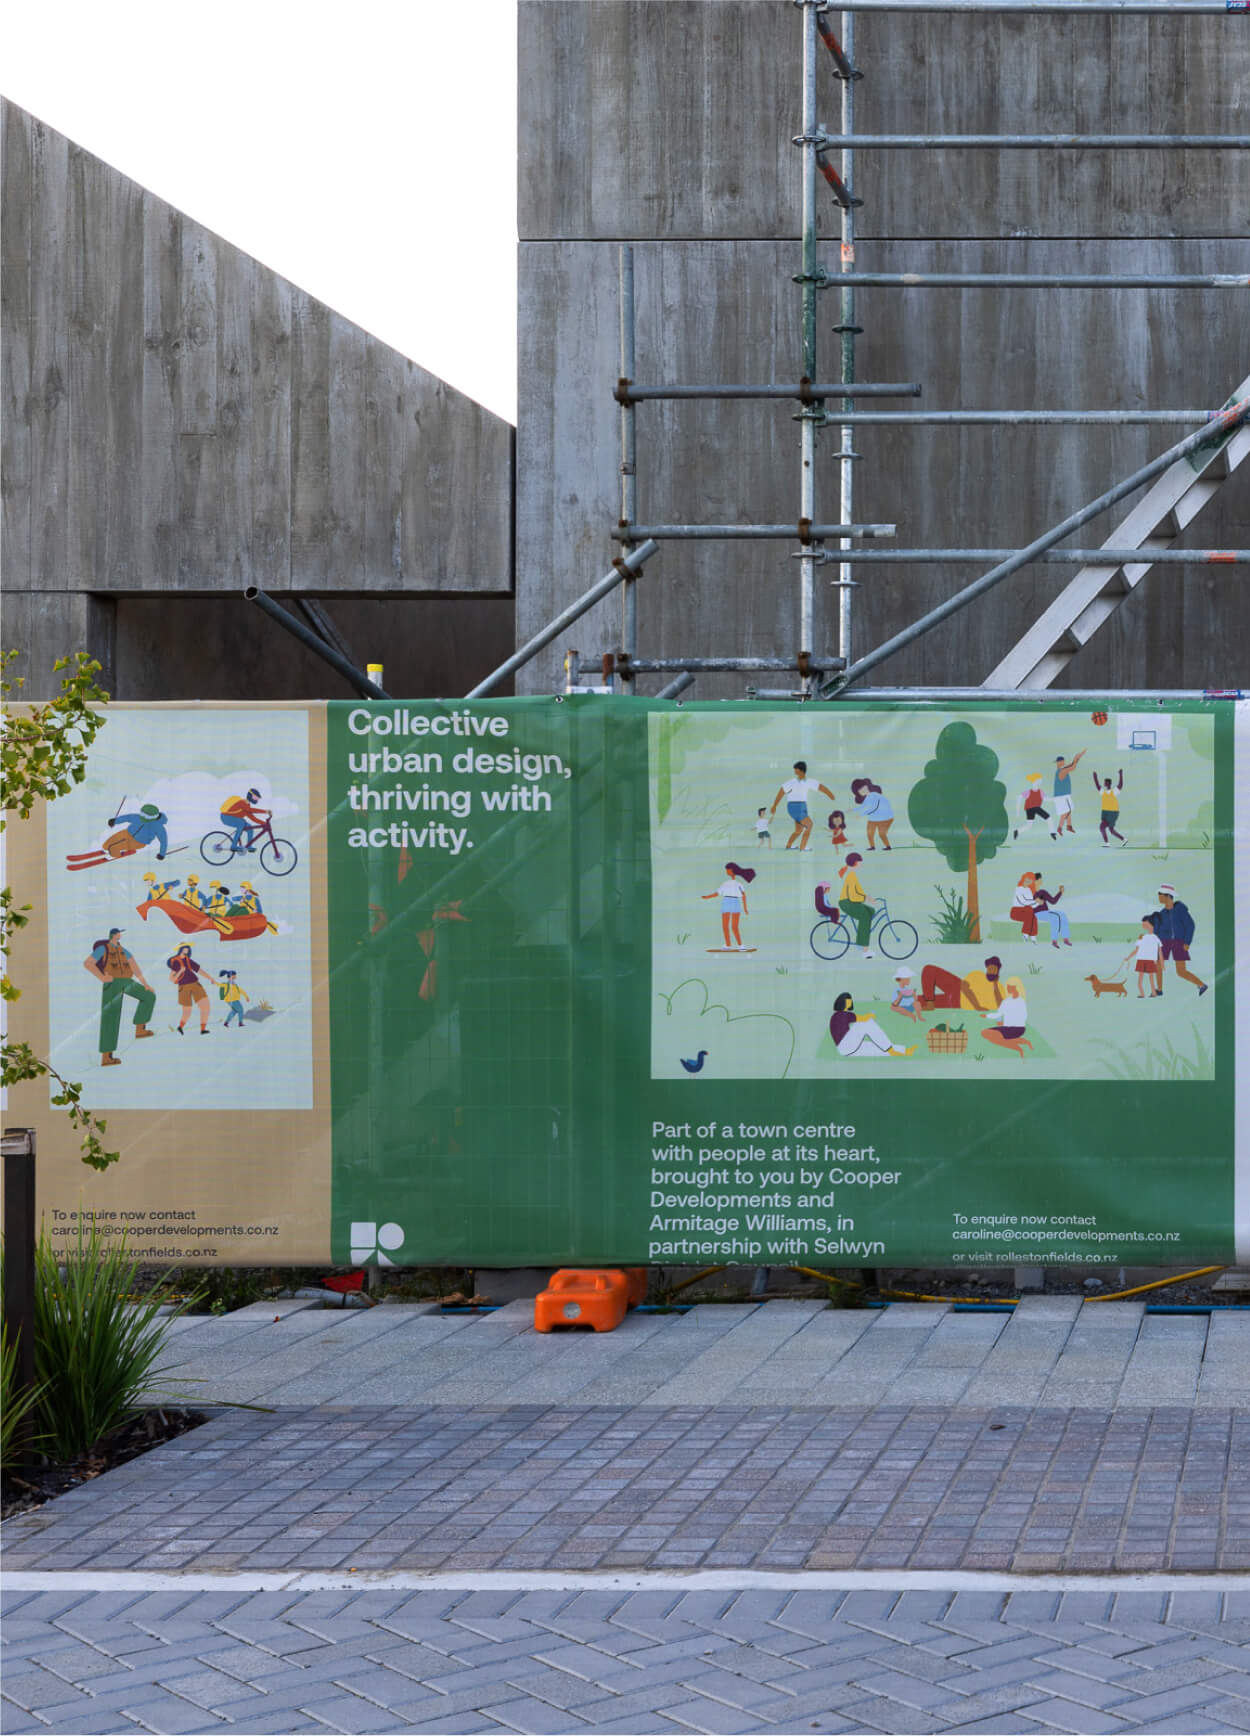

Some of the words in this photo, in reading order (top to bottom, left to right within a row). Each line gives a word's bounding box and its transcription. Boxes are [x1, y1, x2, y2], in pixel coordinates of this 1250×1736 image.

[348, 709, 509, 736] Collective
[349, 747, 442, 773] urban
[452, 747, 571, 781] design,
[348, 784, 471, 818] thriving
[481, 785, 552, 811] with
[348, 821, 474, 855] activity.
[652, 1122, 691, 1138] Part
[696, 1122, 716, 1138] of
[722, 1126, 733, 1138] a
[739, 1123, 787, 1138] town
[793, 1123, 856, 1138] centre
[652, 1145, 693, 1161] with
[699, 1145, 766, 1165] people
[771, 1147, 791, 1161] at
[796, 1145, 818, 1161] its
[825, 1145, 880, 1164] heart,
[651, 1168, 729, 1188] brought
[734, 1170, 753, 1184] to
[760, 1173, 794, 1188] you
[801, 1168, 823, 1188] by
[828, 1168, 902, 1188] Cooper
[650, 1191, 791, 1212] Developments
[797, 1191, 834, 1208] and
[52, 1209, 67, 1221] To
[70, 1209, 117, 1223] enquire
[121, 1211, 145, 1220] now
[149, 1209, 196, 1221] contact
[649, 1214, 739, 1235] Armitage
[746, 1214, 832, 1234] Williams,
[837, 1214, 854, 1231] in
[952, 1213, 968, 1225] To
[970, 1213, 1018, 1227] enquire
[1021, 1216, 1047, 1225] now
[1050, 1215, 1096, 1226] contact
[52, 1224, 279, 1237] caroine@cooperdevelopments.co.nz
[952, 1229, 1181, 1242] caroline@cooperdevelopments.co.nz
[649, 1237, 761, 1258] partnership
[767, 1237, 808, 1254] with
[814, 1237, 885, 1258] Selwyn
[952, 1253, 965, 1262] or
[968, 1251, 993, 1262] visit
[996, 1251, 1118, 1263] rollestonfields.co.nz
